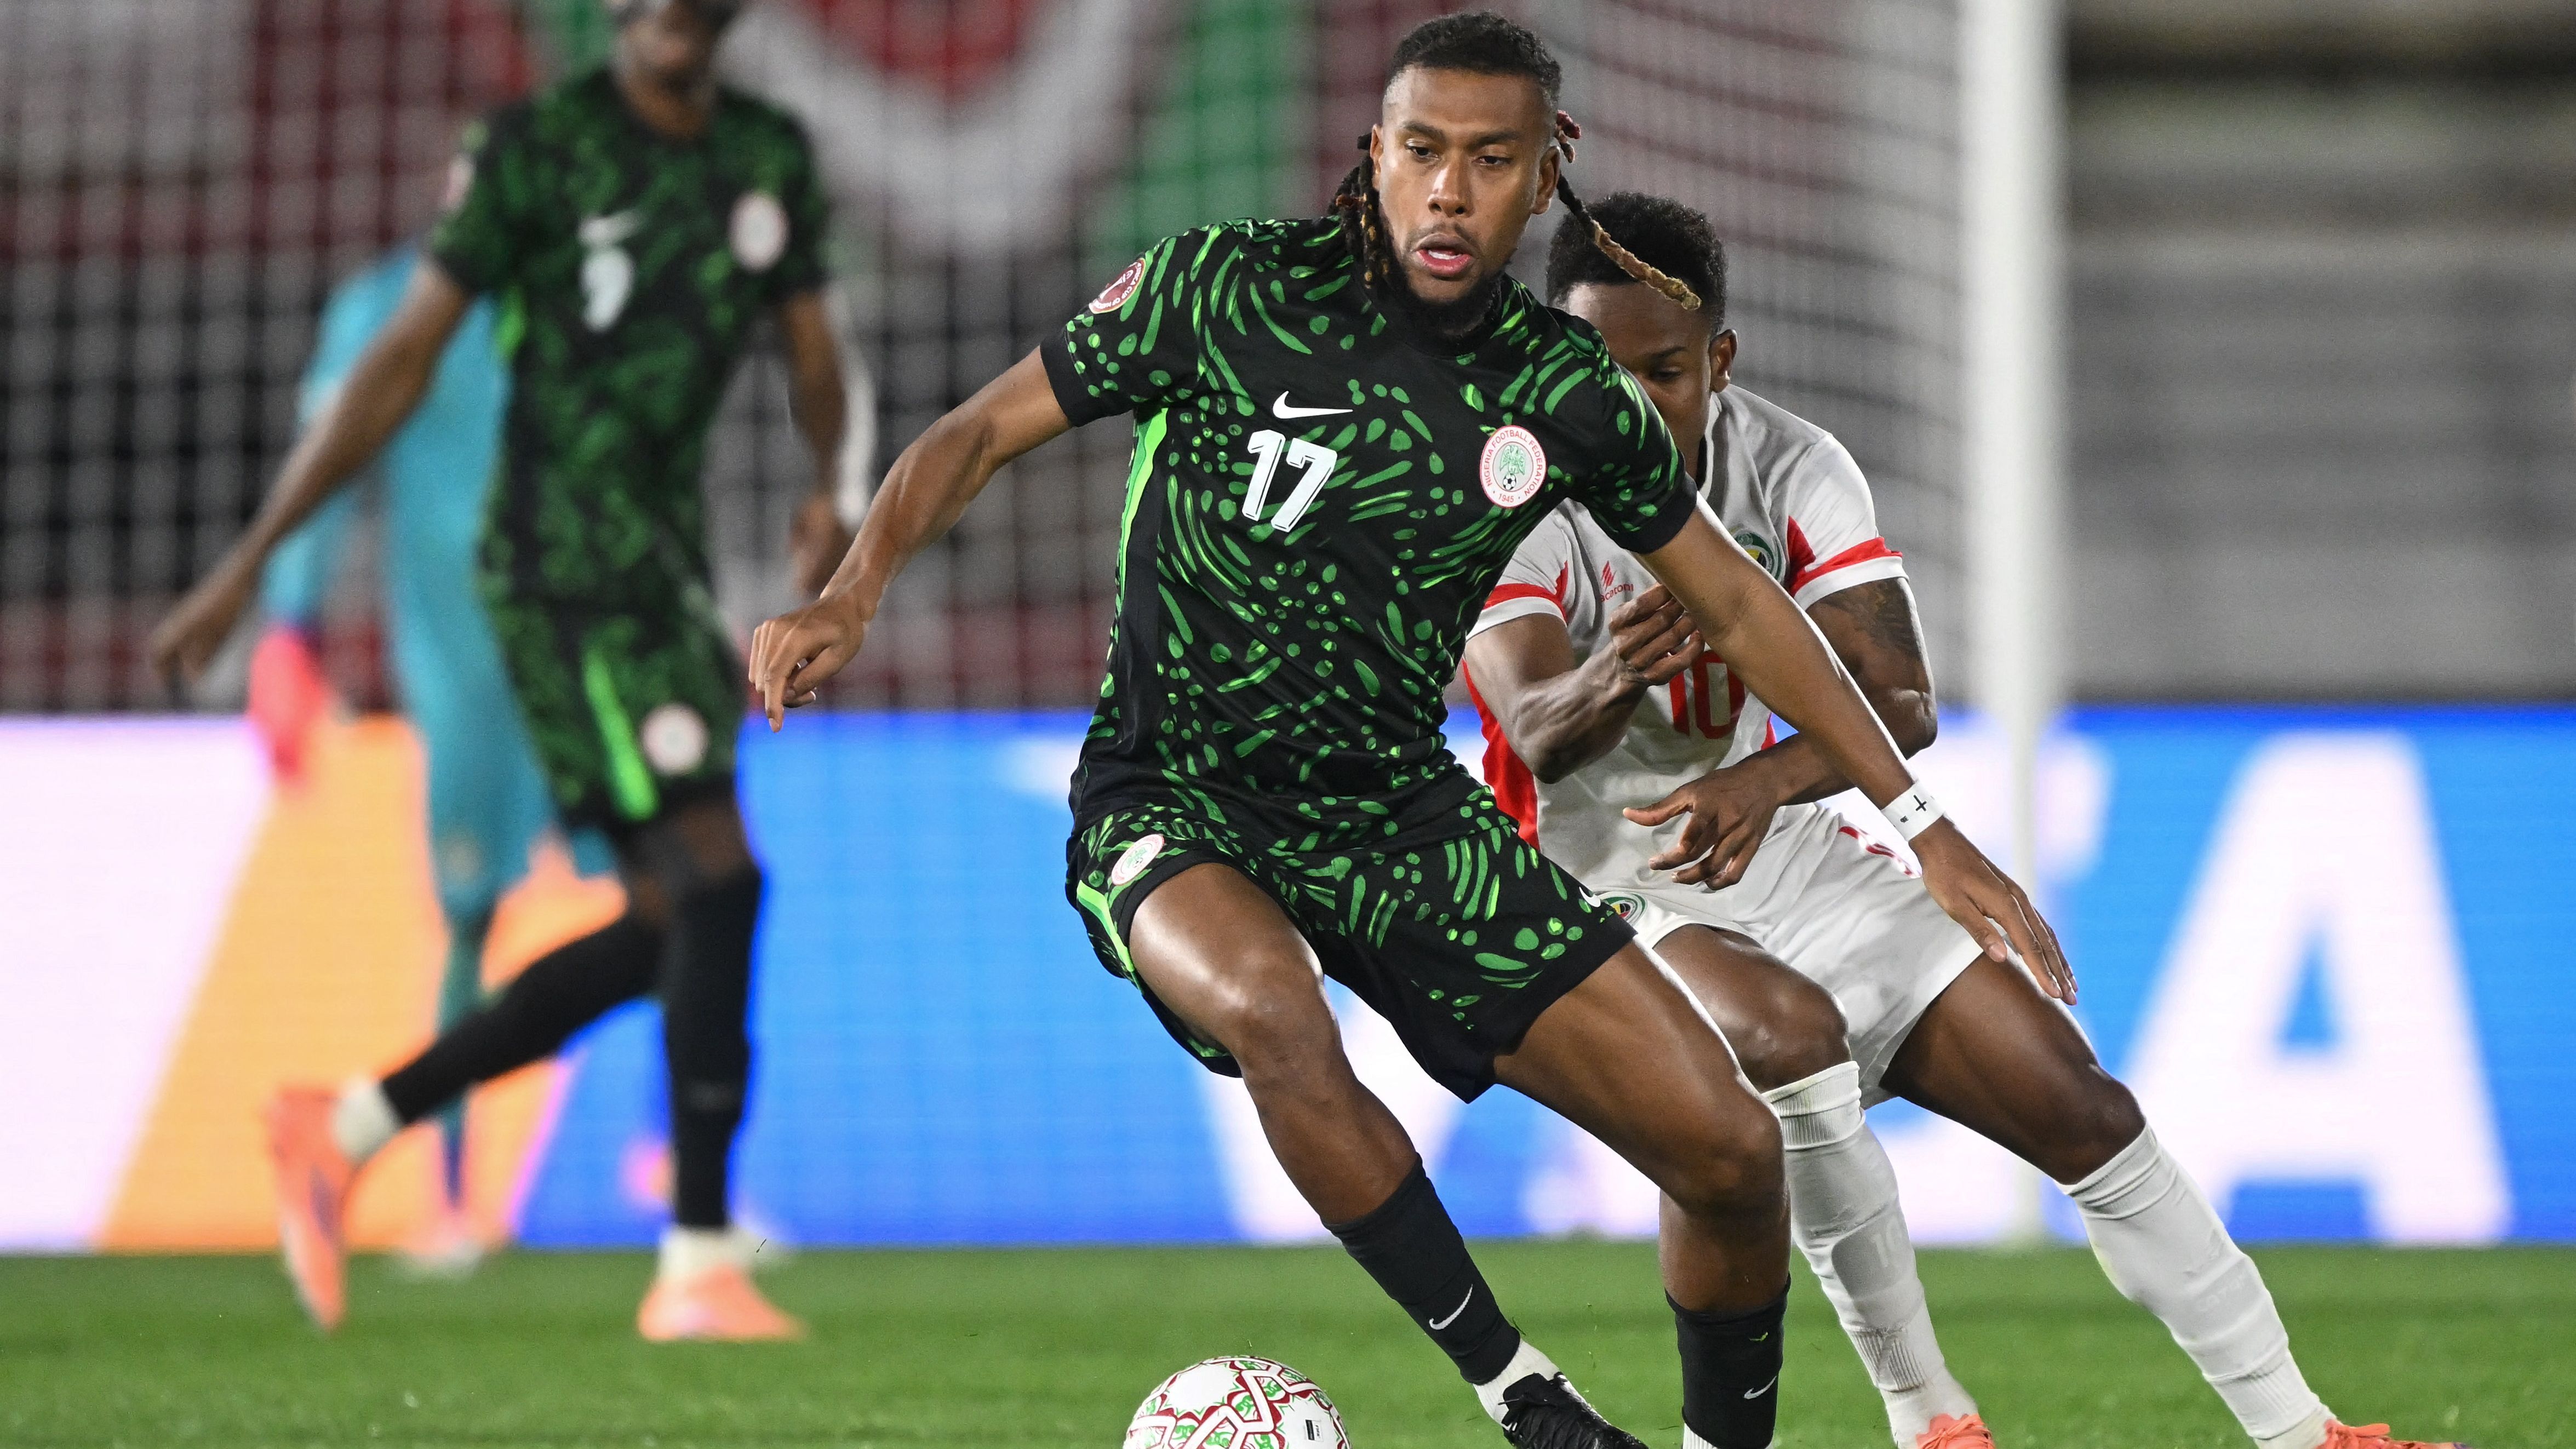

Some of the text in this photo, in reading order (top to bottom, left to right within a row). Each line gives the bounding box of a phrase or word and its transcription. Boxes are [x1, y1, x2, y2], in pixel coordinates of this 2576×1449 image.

[1242, 429, 1337, 532] 17
[1484, 429, 1543, 496] NIGERIA FOOTBALL FEDERATION
[1498, 493, 1514, 503] 1945
